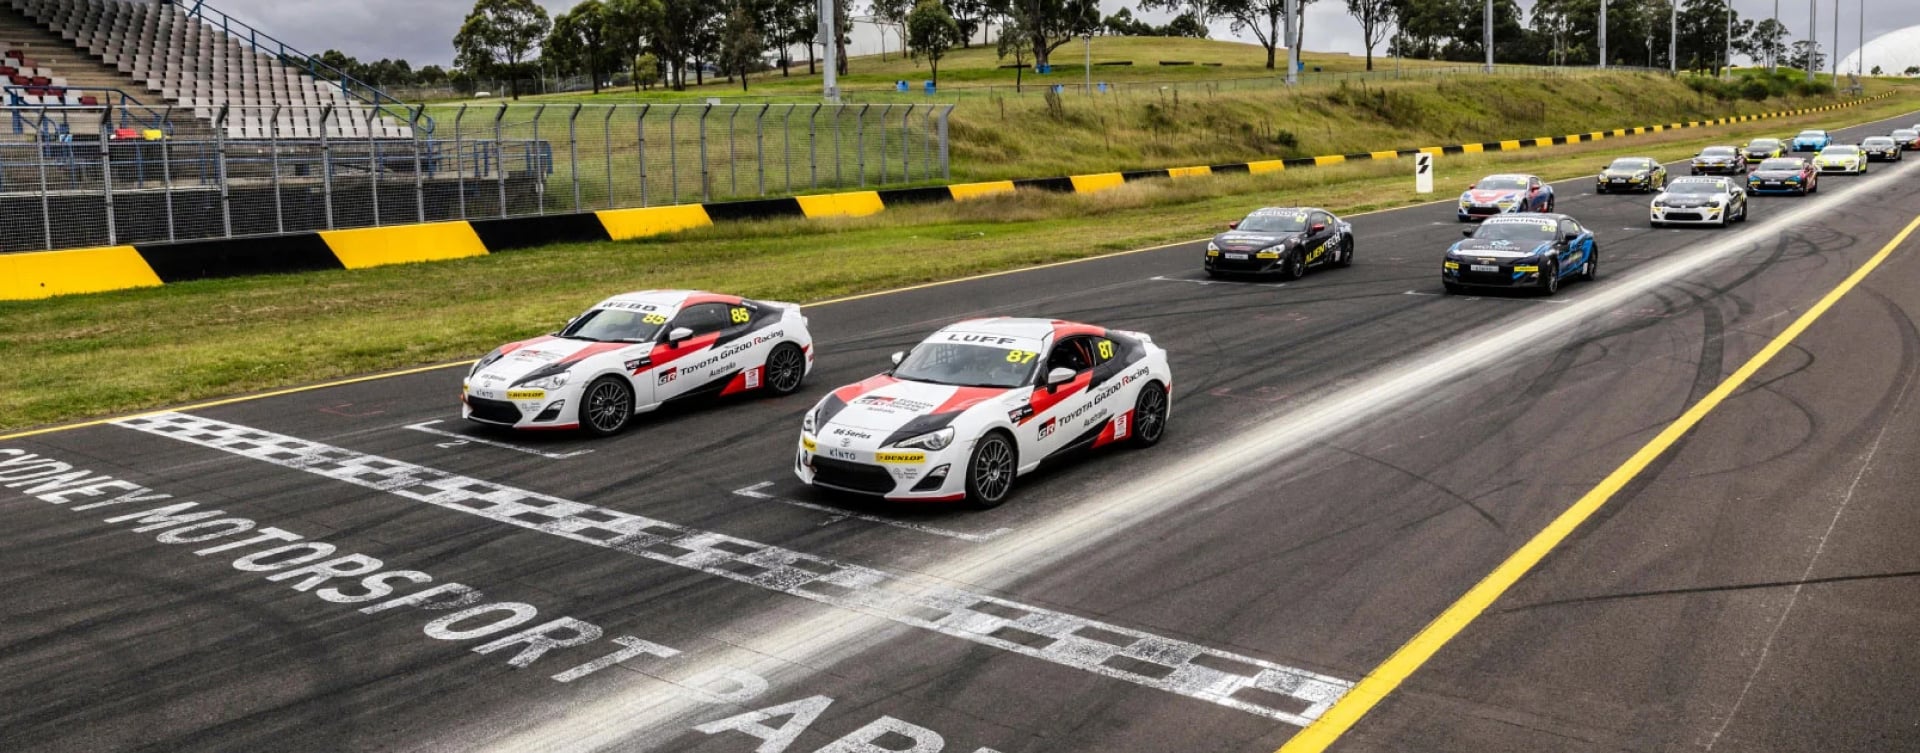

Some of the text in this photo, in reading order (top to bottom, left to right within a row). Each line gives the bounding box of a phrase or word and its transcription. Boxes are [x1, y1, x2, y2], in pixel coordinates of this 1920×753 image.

[1305, 231, 1342, 264] ALIENTECH
[602, 302, 659, 312] WEBB
[730, 307, 750, 324] 85
[641, 313, 667, 325] 85
[948, 334, 1017, 345] LUFF
[680, 329, 784, 376] TOYOTA GAZOO Racing
[1006, 350, 1037, 364] 87
[1097, 339, 1114, 360] 87
[708, 361, 737, 378] Australia
[658, 371, 677, 386] GR
[1058, 401, 1093, 427] TOYOTA
[1094, 382, 1122, 406] GAZOO
[1121, 365, 1150, 386] Racing
[1083, 407, 1109, 429] Australia
[833, 428, 872, 440] 86 Series
[1037, 422, 1056, 441] GR
[829, 448, 857, 460] KINTO
[884, 454, 924, 462] DUNLOP
[103, 500, 682, 683] MOTORSPORT
